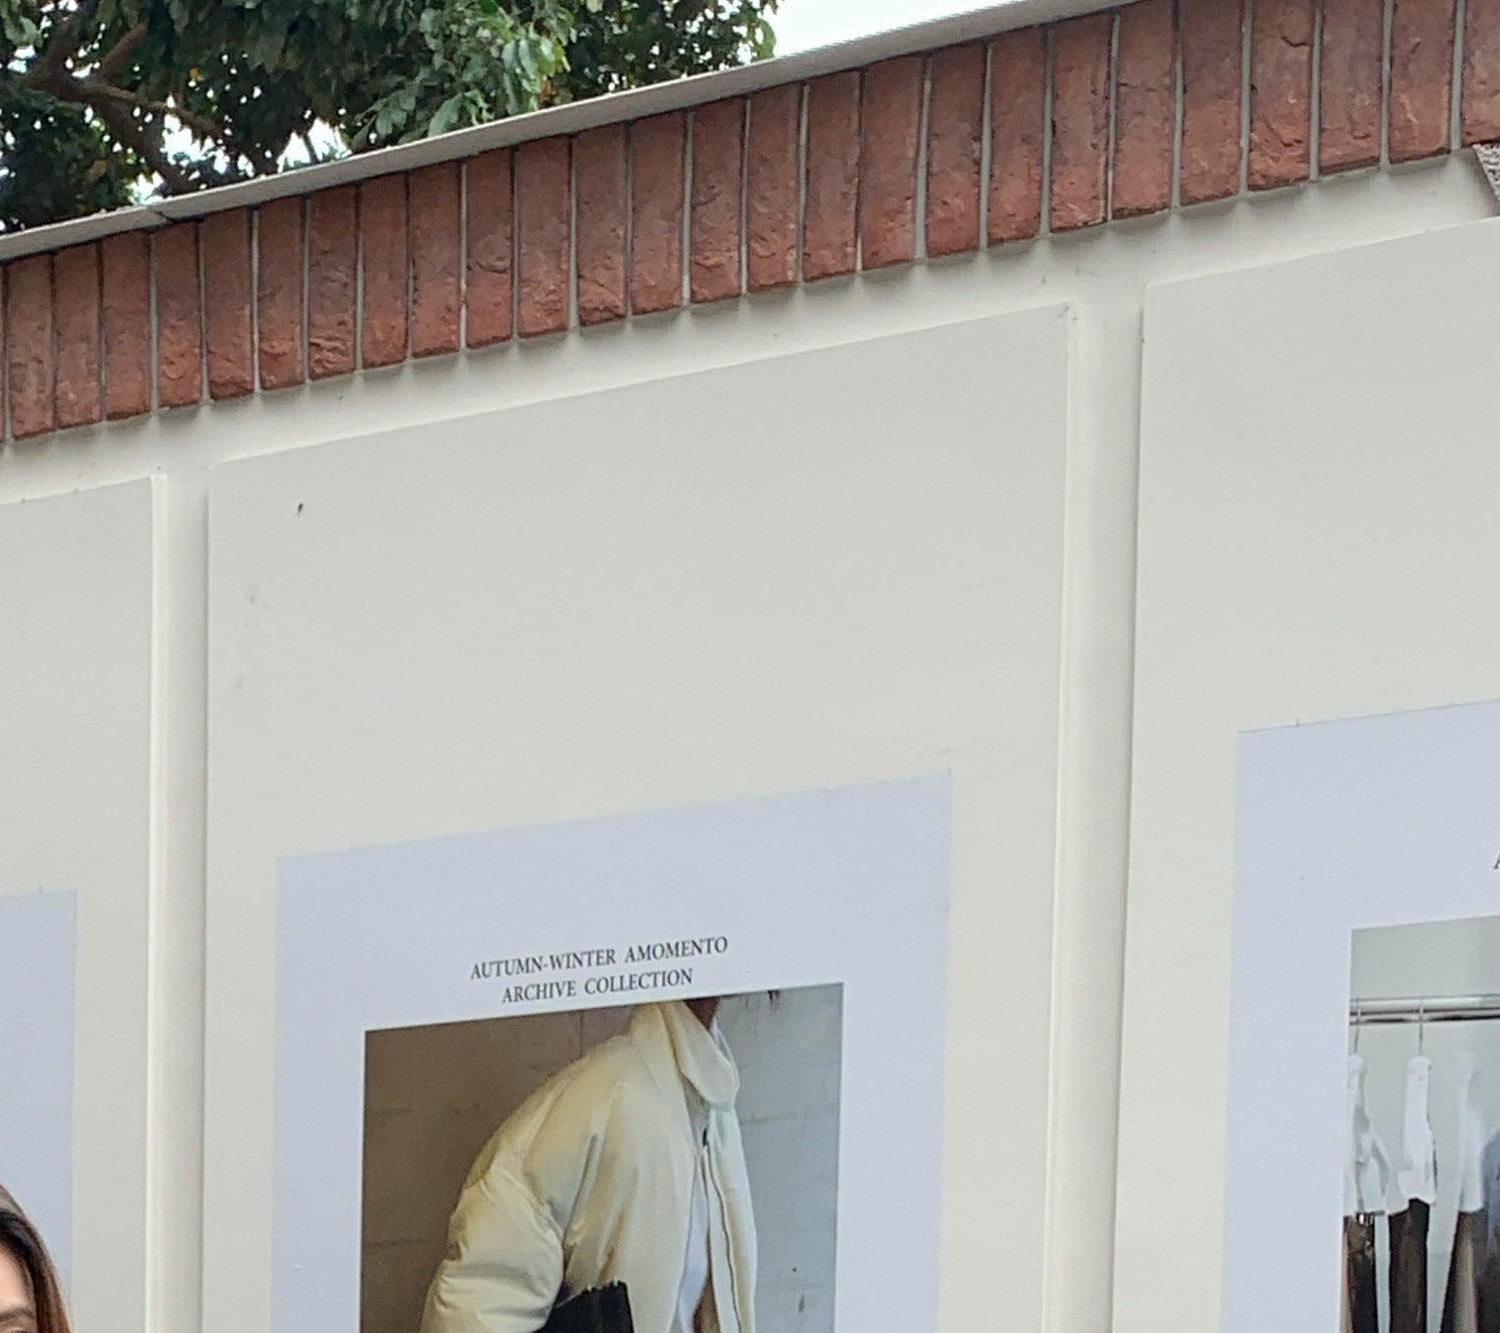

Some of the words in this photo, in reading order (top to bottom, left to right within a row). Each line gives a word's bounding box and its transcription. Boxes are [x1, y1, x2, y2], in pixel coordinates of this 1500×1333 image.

[470, 948, 617, 980] AUTUMN-WINTER
[624, 936, 728, 963] AMOMENTO
[501, 979, 577, 1004] ARCHIVE
[584, 968, 693, 995] COLLECTION
